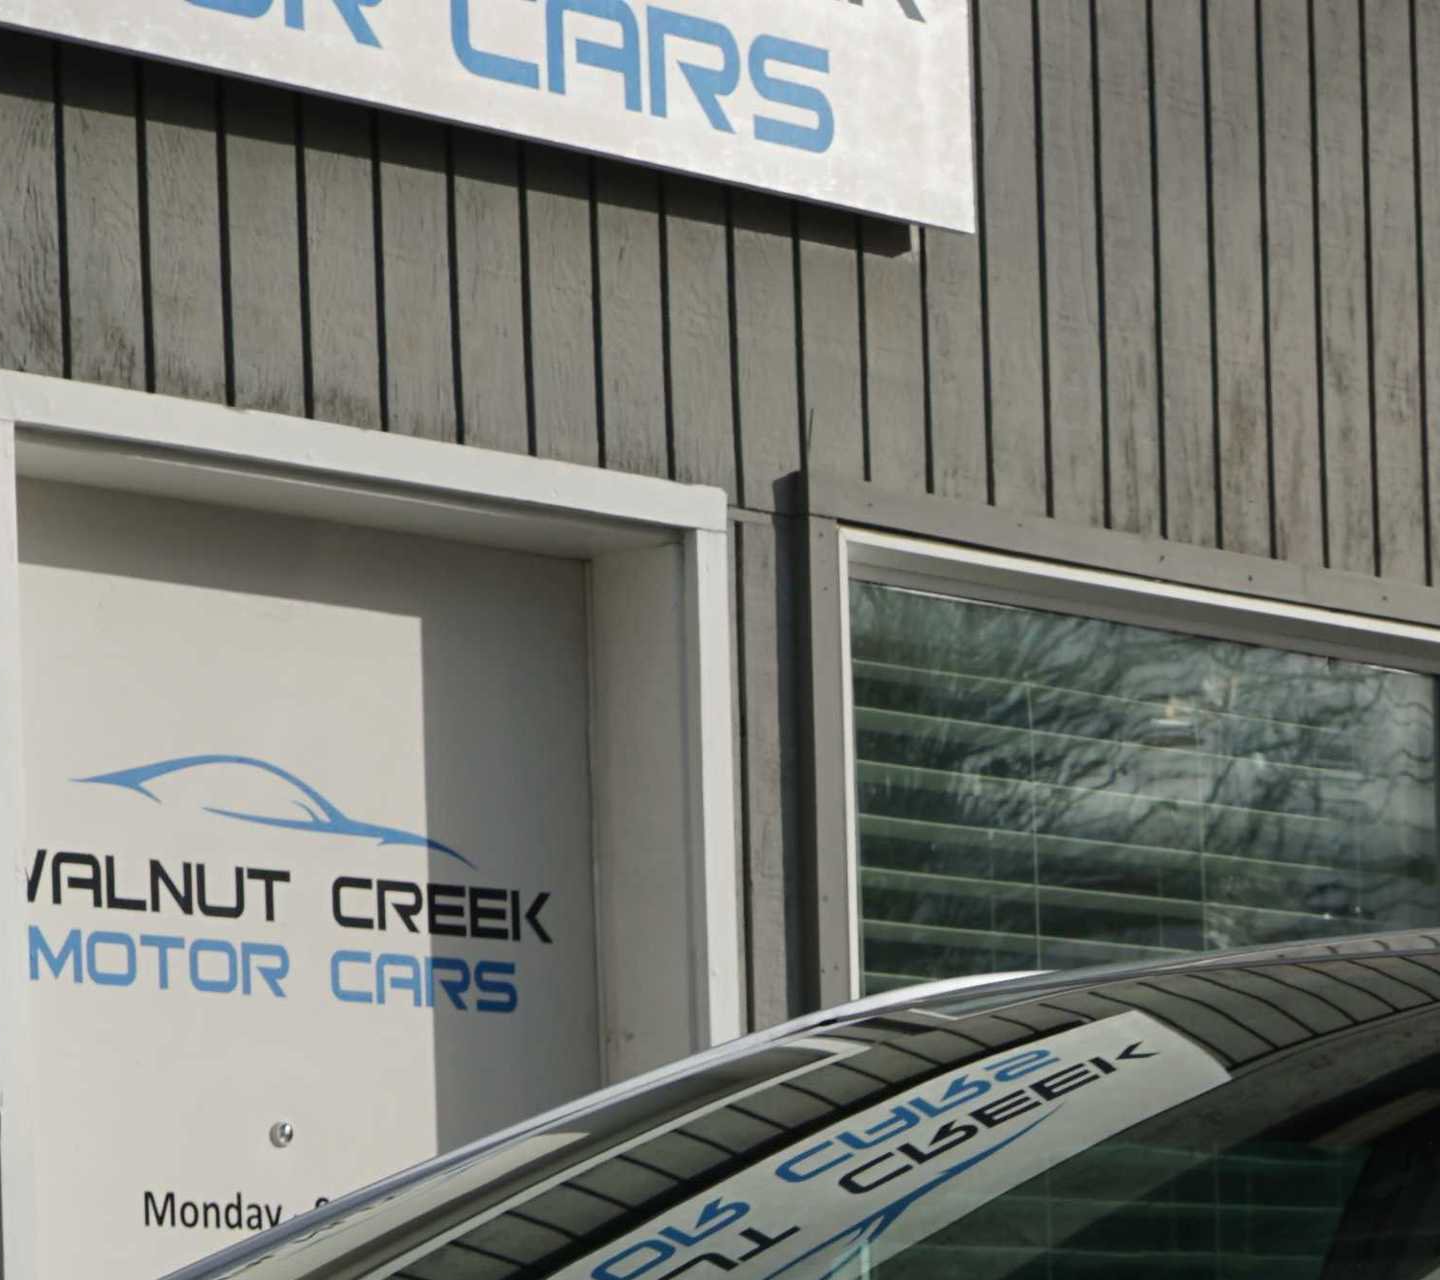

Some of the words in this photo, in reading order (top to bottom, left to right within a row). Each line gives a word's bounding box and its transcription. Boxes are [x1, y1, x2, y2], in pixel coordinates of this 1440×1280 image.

[450, 0, 835, 154] CARS
[331, 876, 553, 944] CREEK
[28, 924, 290, 999] MOTOR
[330, 950, 518, 1014] CARS
[144, 1190, 283, 1230] Monday
